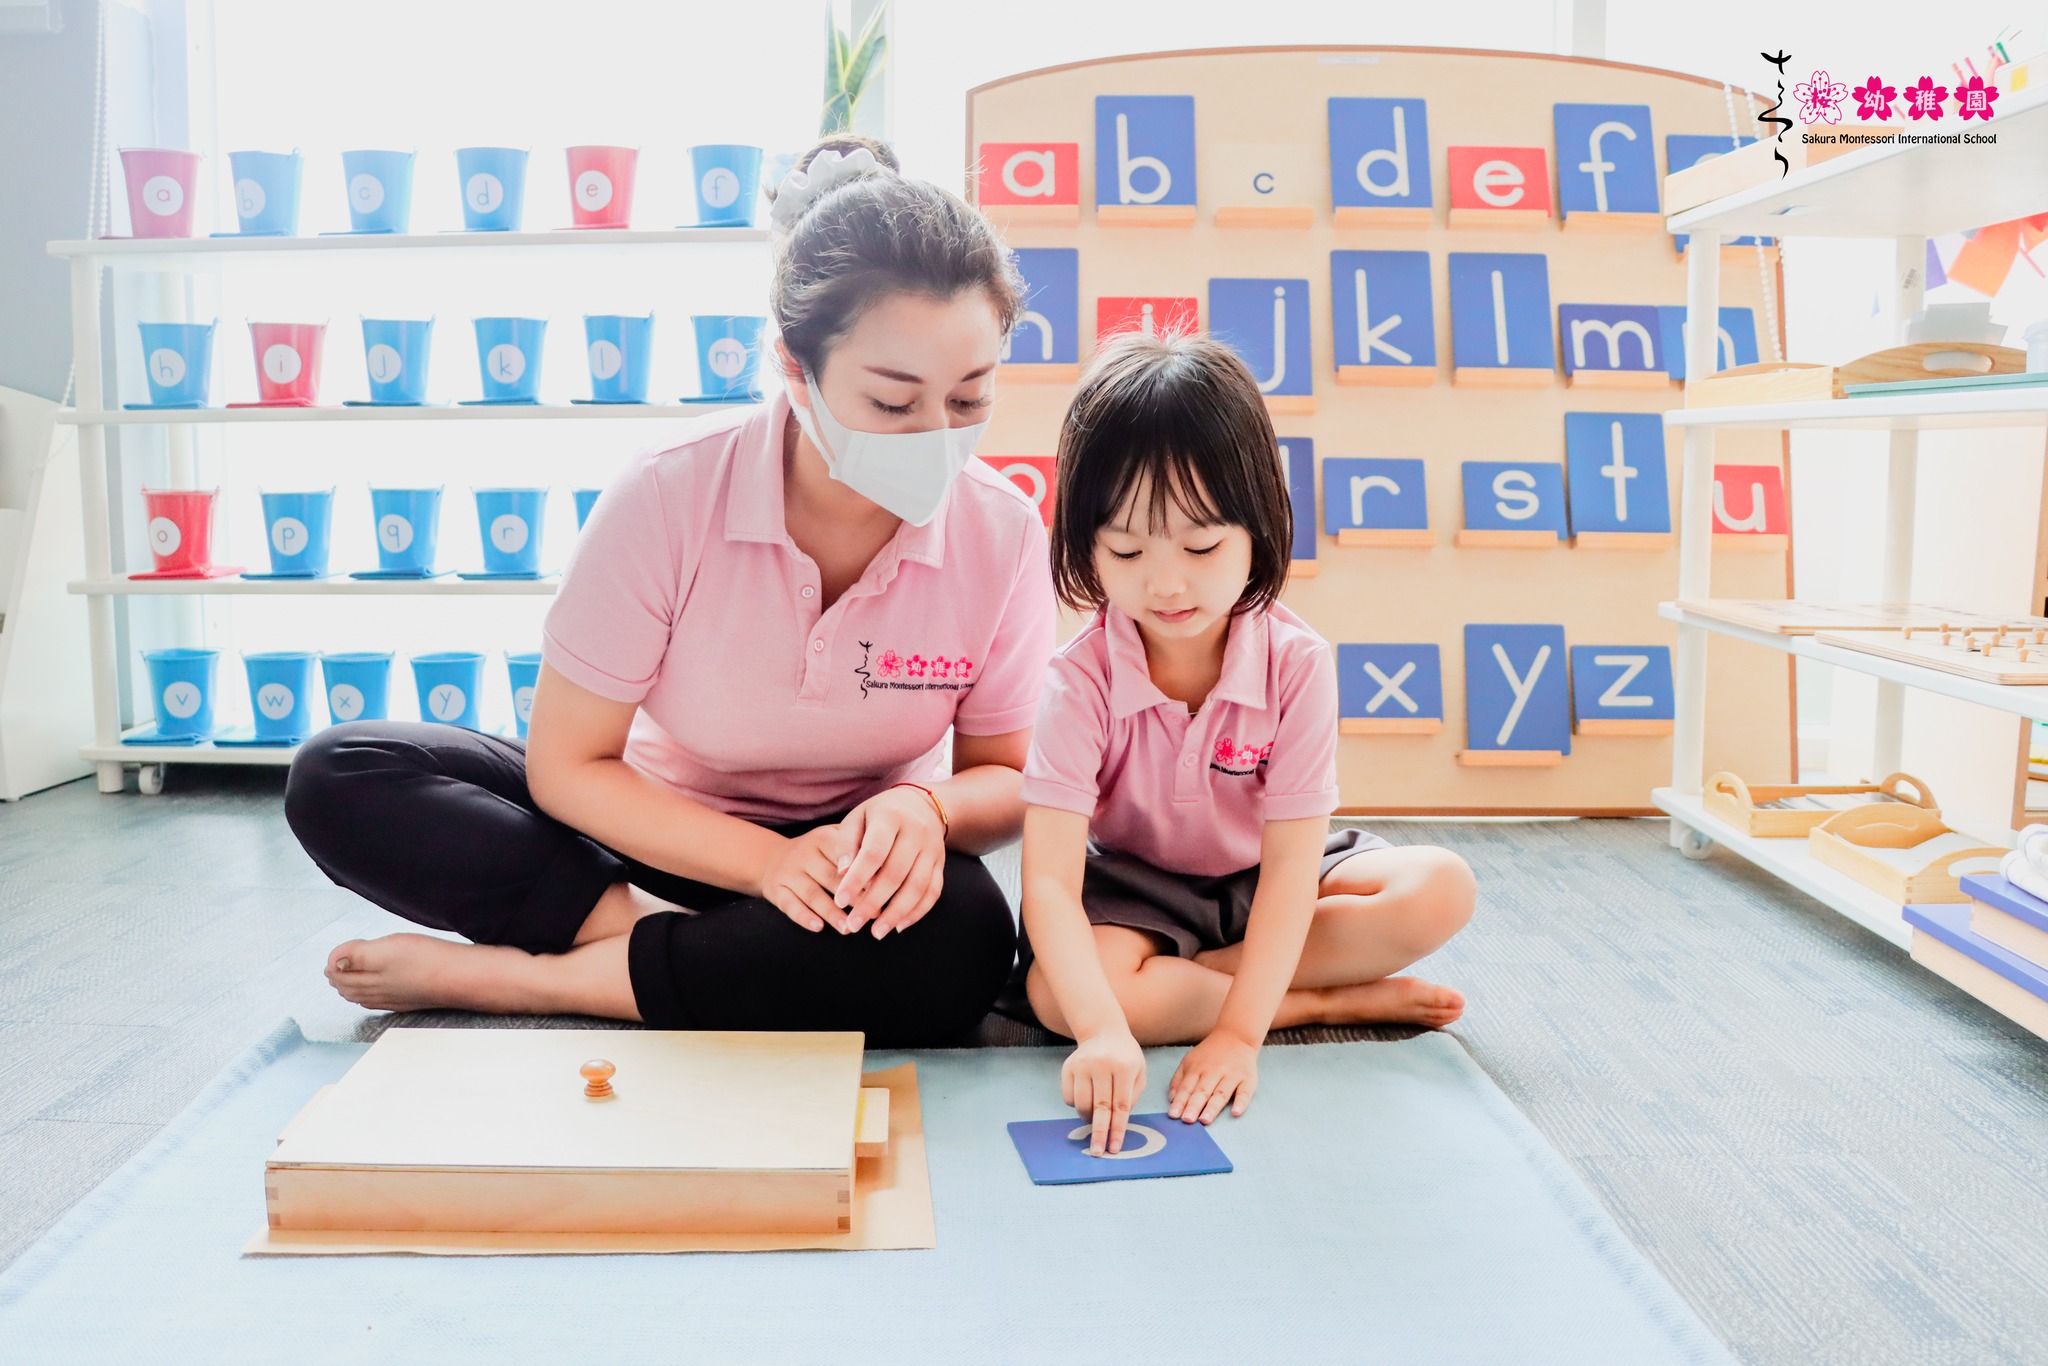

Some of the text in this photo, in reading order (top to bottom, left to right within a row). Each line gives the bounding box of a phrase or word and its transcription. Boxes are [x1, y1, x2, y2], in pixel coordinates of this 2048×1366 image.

[1116, 113, 1172, 205] b
[1356, 105, 1410, 197] d
[1002, 150, 1056, 198] a
[1578, 121, 1637, 213] f
[156, 187, 171, 203] a
[358, 185, 372, 201] c
[476, 180, 490, 206] d
[585, 183, 600, 198] e
[712, 174, 727, 200] f
[1253, 172, 1275, 194] c
[1473, 160, 1525, 208] e
[238, 186, 254, 212] b
[1355, 268, 1413, 364] k
[1491, 270, 1509, 365] l
[1256, 286, 1286, 394] j
[1570, 319, 1655, 369] m
[158, 354, 175, 378] h
[278, 354, 284, 373] i
[499, 351, 513, 376] k
[714, 349, 740, 366] m
[1600, 421, 1639, 522] t
[1350, 475, 1400, 526] r
[1491, 470, 1540, 520] s
[1713, 480, 1767, 533] u
[156, 529, 168, 544] o
[281, 526, 296, 551] p
[386, 524, 400, 549] q
[502, 526, 515, 541] r
[865, 680, 889, 690] Sakura
[889, 681, 924, 691] Montessori
[1362, 660, 1420, 714] x
[1491, 642, 1551, 746] y
[1593, 655, 1655, 707] z
[175, 693, 189, 706] v
[264, 695, 285, 708] w
[338, 695, 352, 709] x
[439, 690, 453, 715] y
